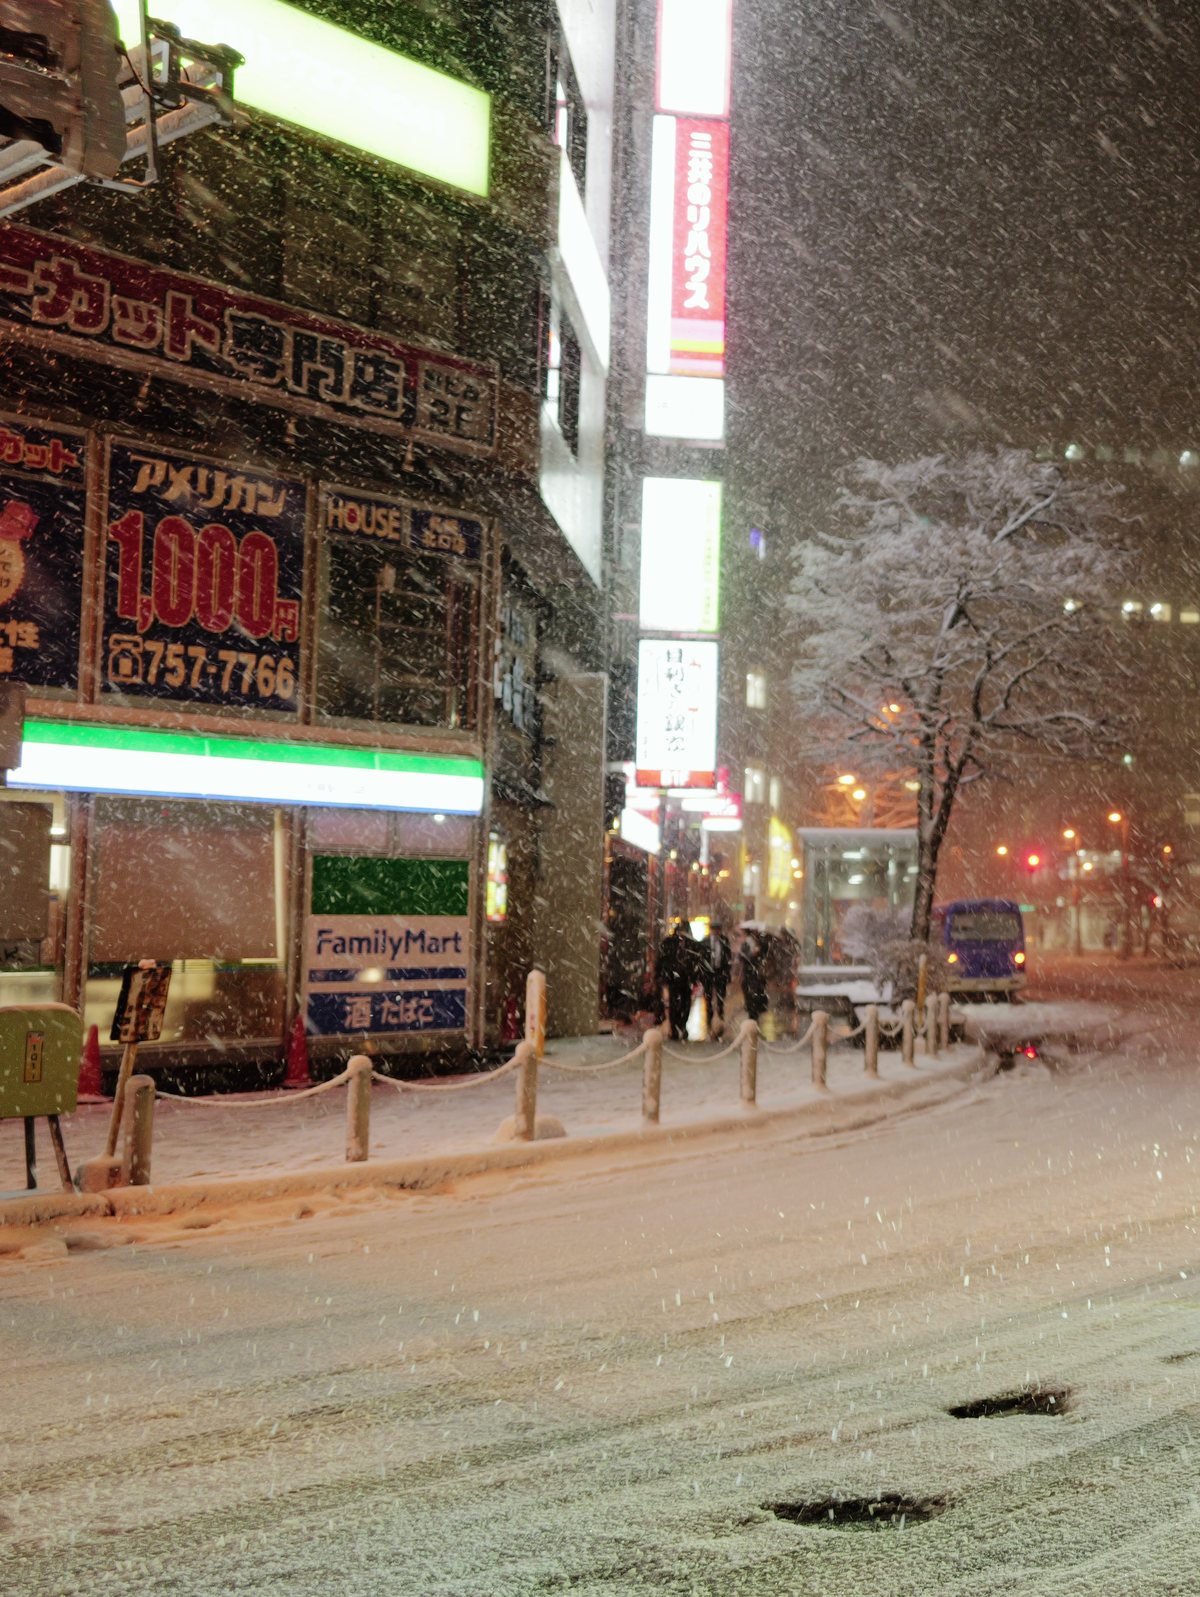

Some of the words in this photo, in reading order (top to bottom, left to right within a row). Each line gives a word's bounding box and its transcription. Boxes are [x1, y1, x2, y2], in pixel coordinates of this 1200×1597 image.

[684, 131, 713, 309] 三井のリハウス
[130, 453, 287, 518] アメリカン
[327, 496, 401, 541] HOUSE
[144, 639, 296, 699] 757-7766
[316, 928, 463, 961] FamilyMart
[344, 996, 372, 1029] 酒
